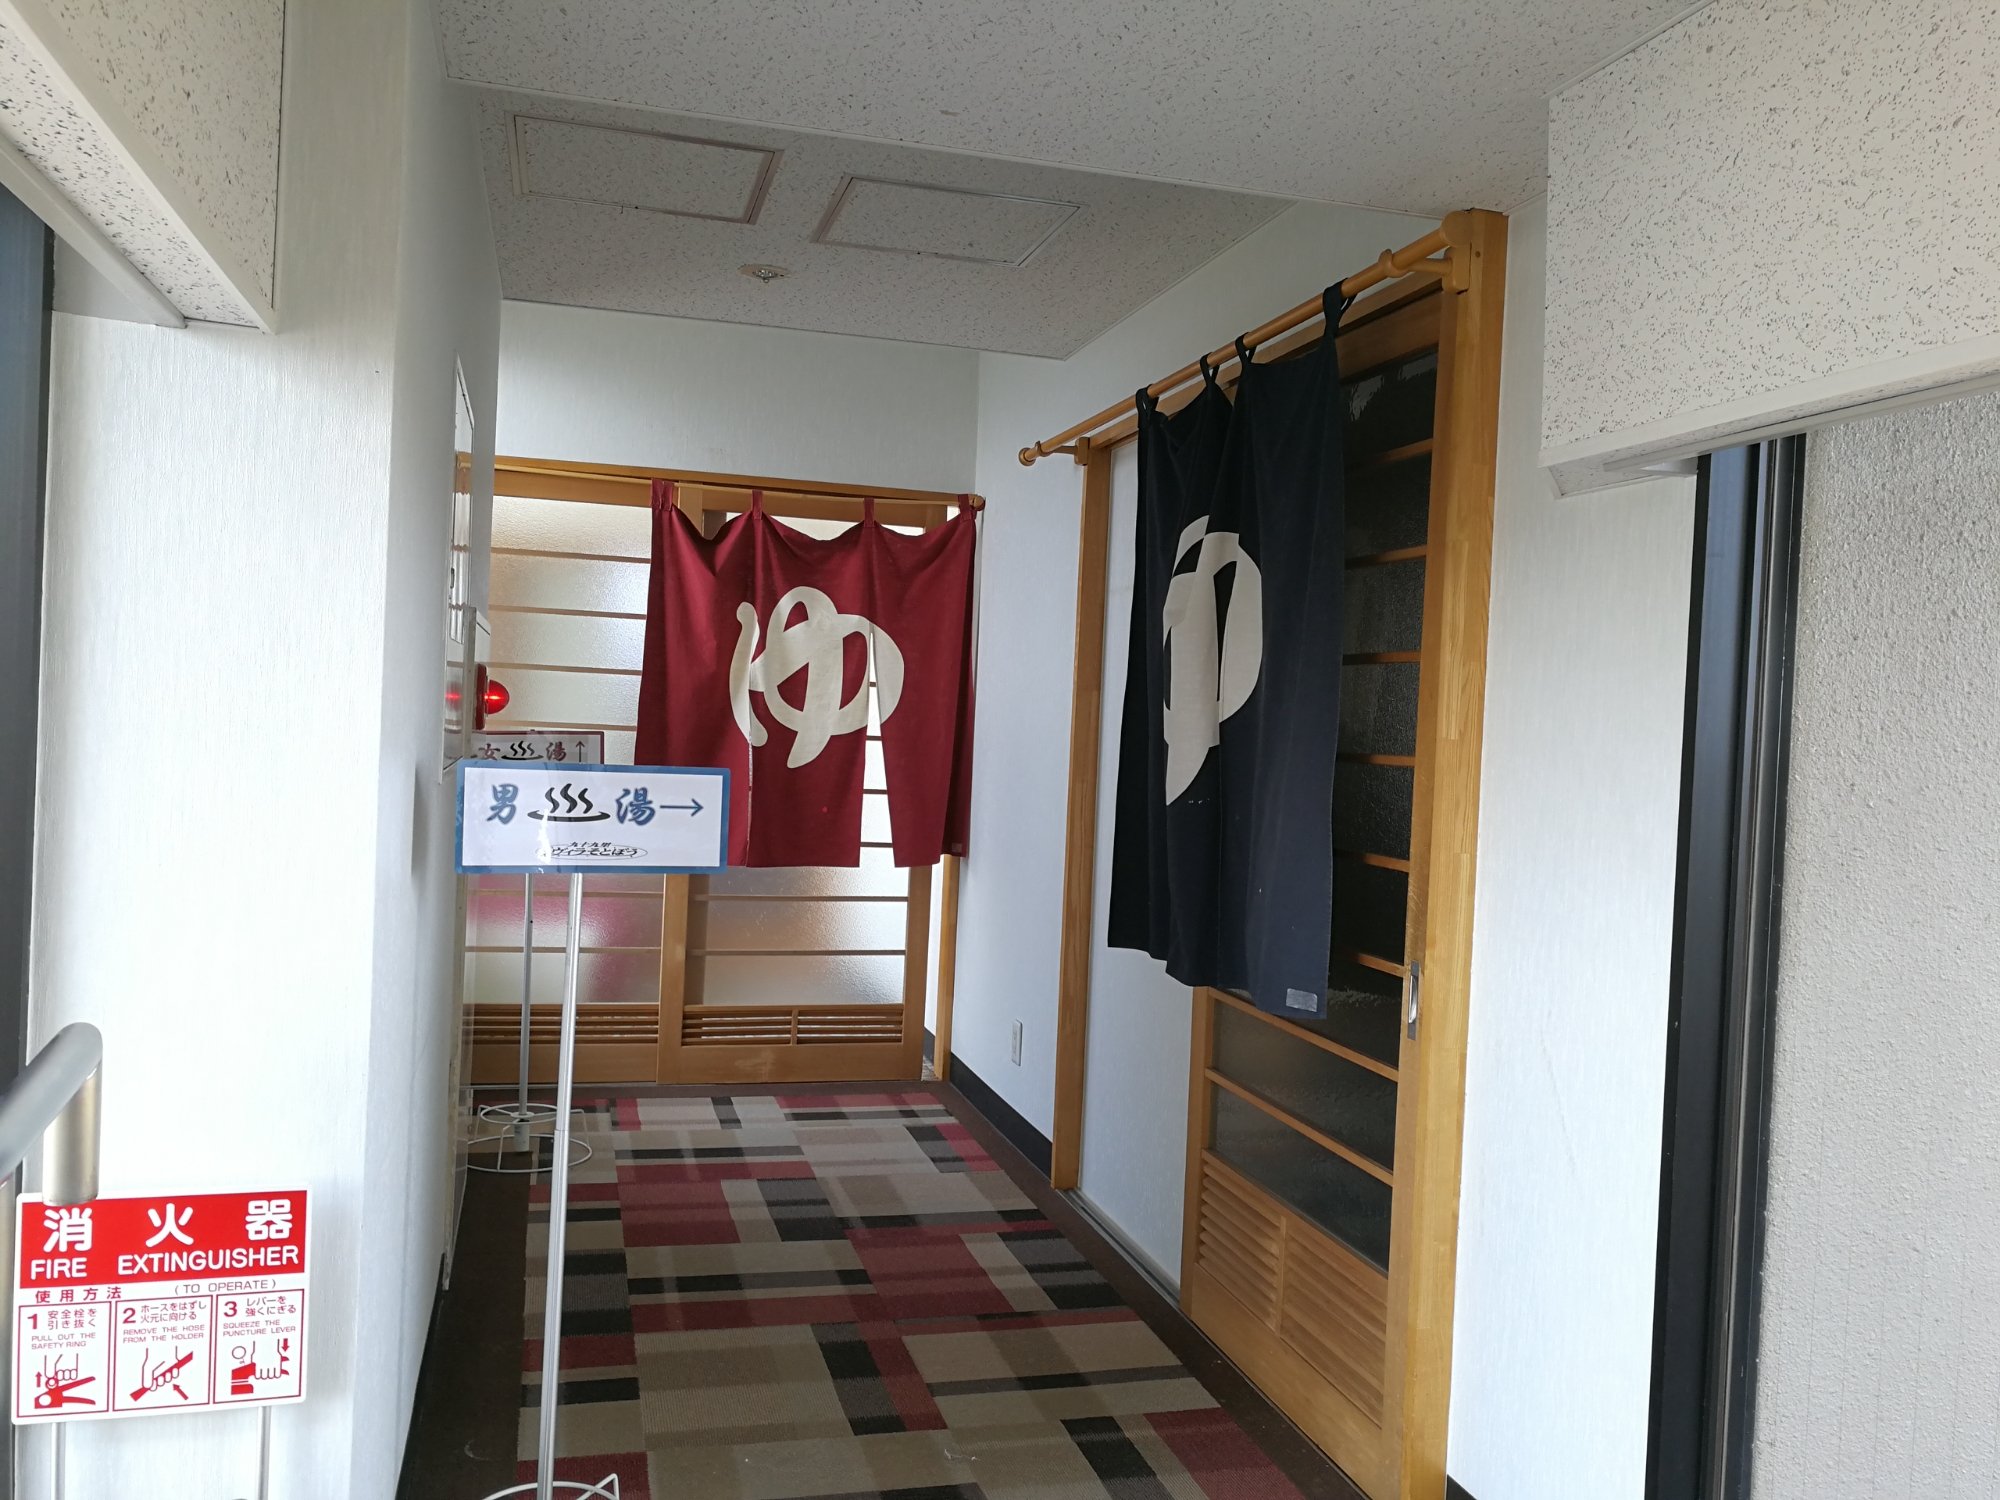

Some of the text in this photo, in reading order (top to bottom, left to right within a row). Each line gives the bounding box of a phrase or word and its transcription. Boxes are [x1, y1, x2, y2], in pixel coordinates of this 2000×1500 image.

[729, 586, 905, 768] ゆ
[479, 741, 567, 761] 女 湯
[486, 783, 656, 826] 男 湯
[43, 1199, 293, 1252] 消火器
[31, 1245, 299, 1280] FIRE EXTINGUISHER
[35, 1287, 121, 1303] 使用方法
[246, 1295, 286, 1307] レバーを
[140, 1300, 207, 1313] ホースをはずし
[223, 1301, 238, 1317] 3
[245, 1304, 297, 1317] 強くにぎる
[47, 1308, 97, 1320] 安全栓を
[122, 1307, 136, 1324] 2
[140, 1311, 197, 1323] 火元に向ける
[27, 1313, 38, 1330] 1
[47, 1318, 96, 1330] 引き抜く
[223, 1320, 261, 1329] SQUEEZE
[123, 1324, 205, 1336] REMOVE THE HOSE
[223, 1325, 296, 1337] PUNCTURE LEVER
[57, 1333, 75, 1341] OUT
[123, 1332, 204, 1344] FROM THE HOLDER
[31, 1340, 87, 1350] SAFETY RING
